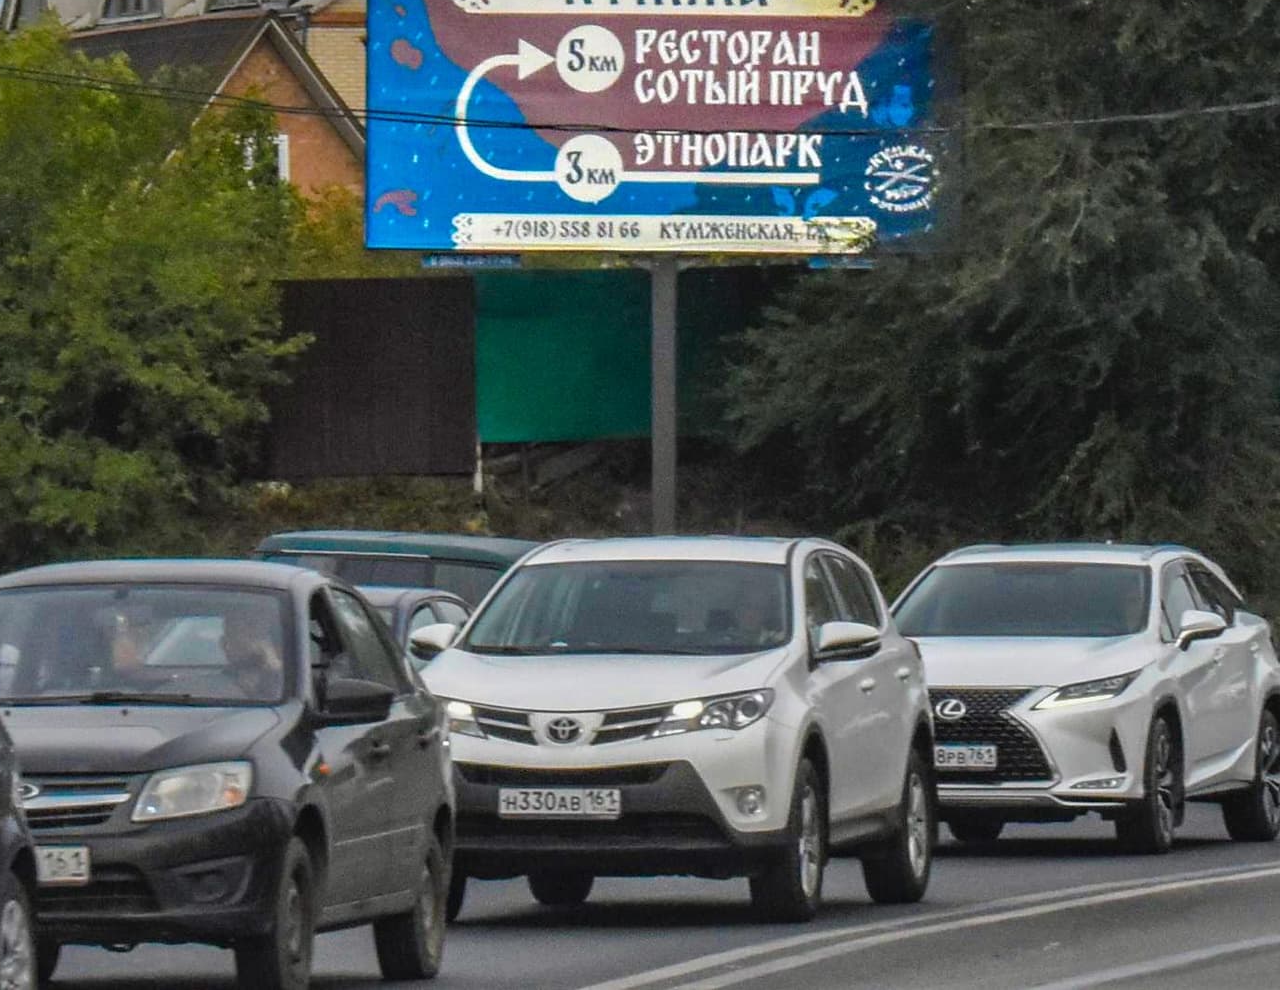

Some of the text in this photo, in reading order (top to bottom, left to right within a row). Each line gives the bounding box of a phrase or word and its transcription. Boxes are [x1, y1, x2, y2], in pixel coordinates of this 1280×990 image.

[634, 29, 820, 66] РЕСТОРАН
[634, 62, 868, 118] СОТЫЙ ПРУД
[634, 131, 822, 168] ЭТНОПАРК
[494, 220, 556, 240] +7(918)
[560, 220, 591, 238] 558
[597, 220, 614, 238] 81
[620, 221, 641, 238] 66
[505, 790, 617, 811] Н330АВ 161
